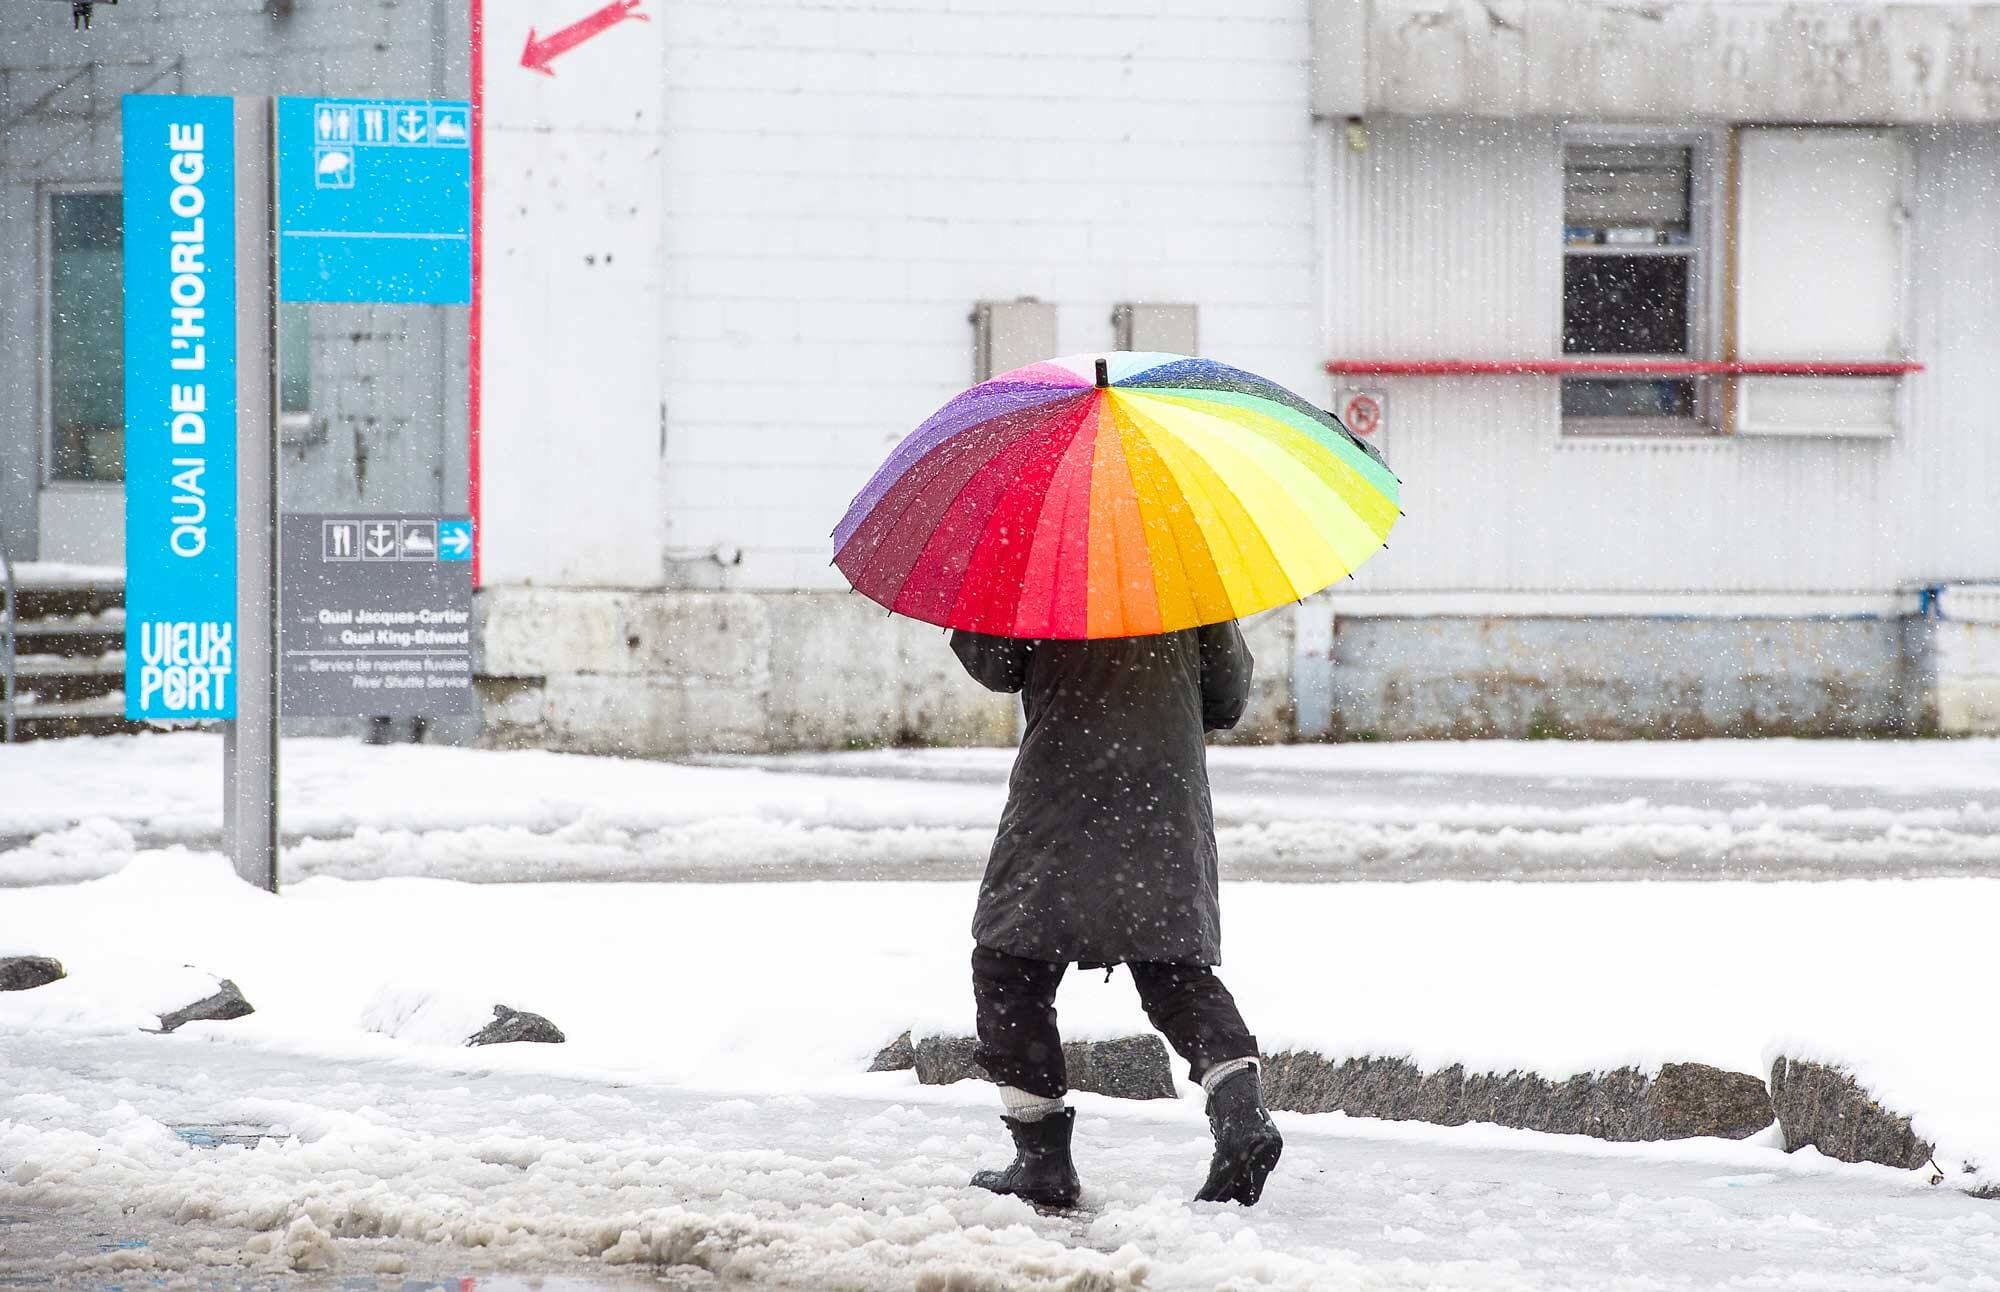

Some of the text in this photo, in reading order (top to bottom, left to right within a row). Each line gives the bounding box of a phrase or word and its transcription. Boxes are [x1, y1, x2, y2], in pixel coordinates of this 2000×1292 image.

[168, 123, 208, 559] QUAI DE L'HORLOGE
[319, 608, 352, 624] Quai
[356, 608, 470, 626] Jacques-Cartier
[141, 621, 232, 667] VIEUX
[341, 629, 375, 644] Quai
[377, 629, 469, 647] King-Edward
[310, 658, 354, 672] Service
[356, 658, 372, 672] de
[374, 659, 422, 672] navettes
[424, 658, 469, 672] fluviales
[140, 665, 232, 711] PORT
[352, 675, 469, 689] River Shuttle Service
